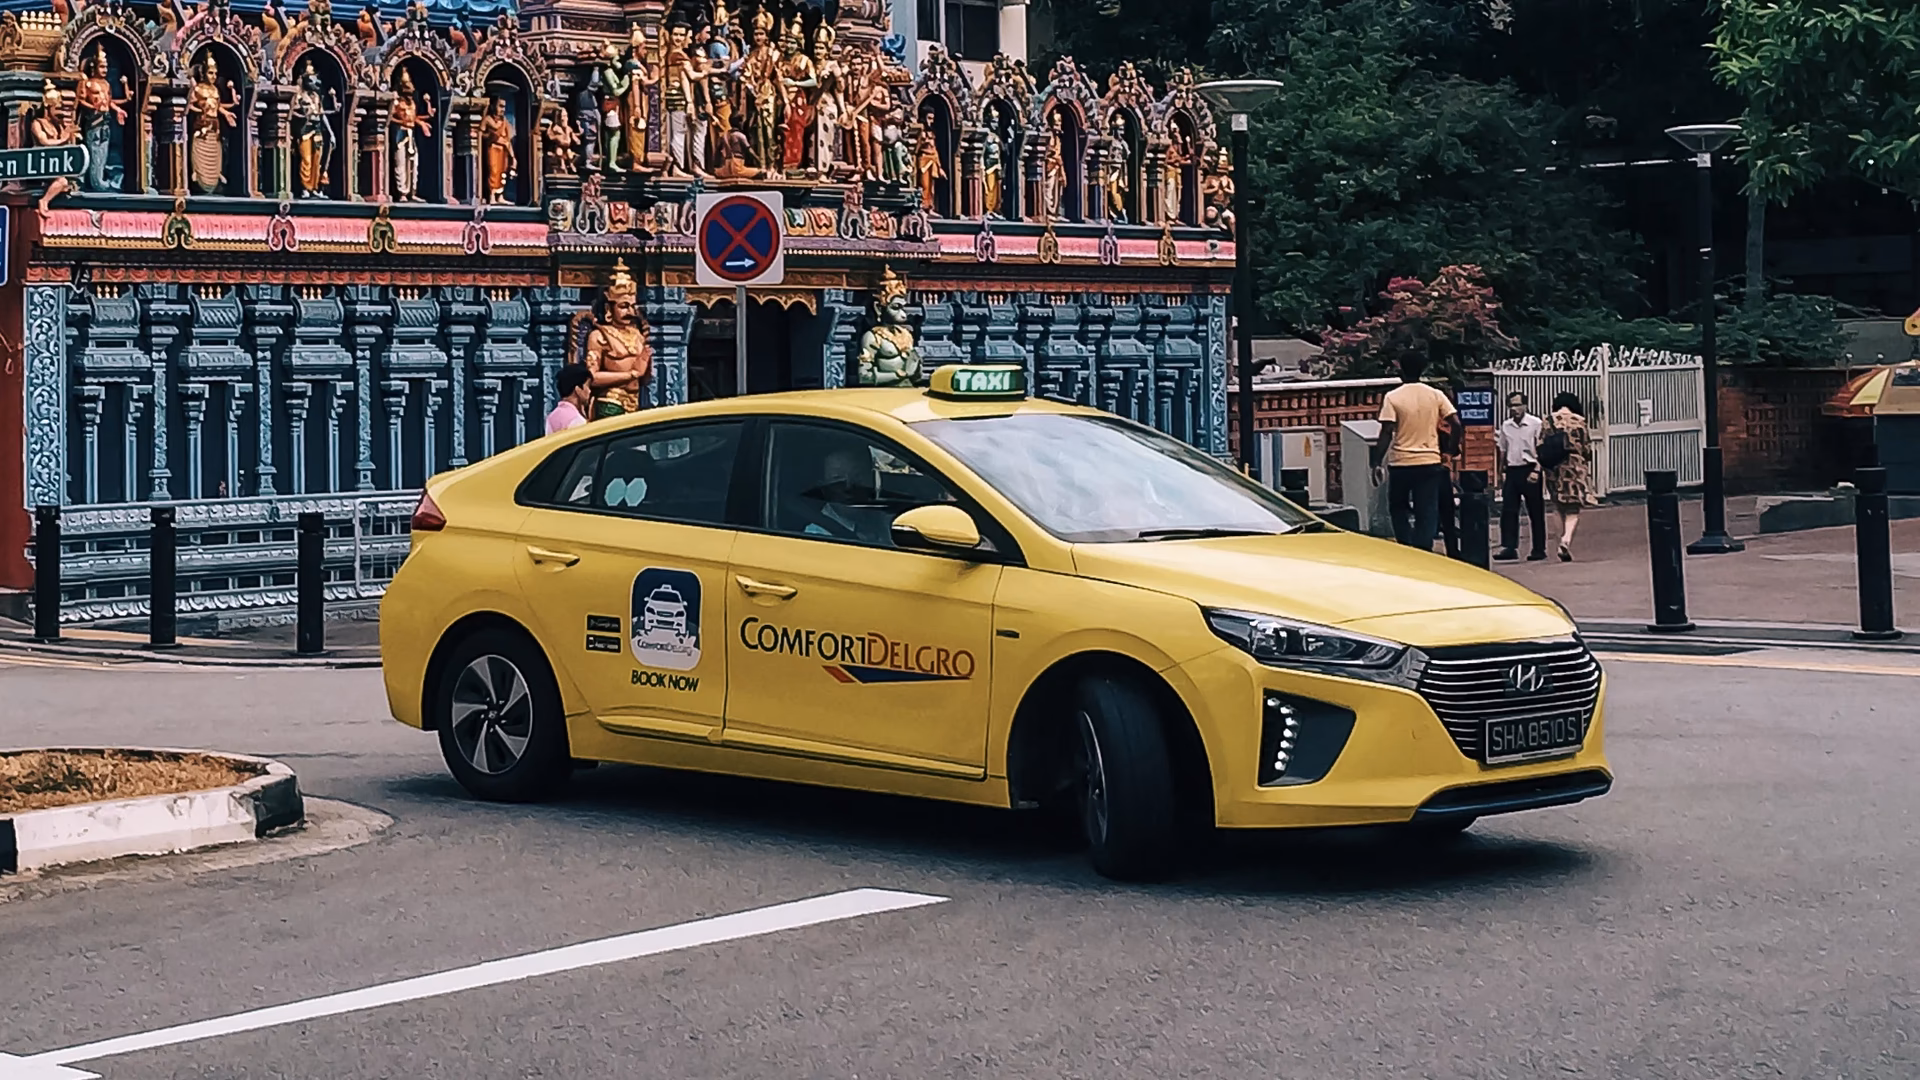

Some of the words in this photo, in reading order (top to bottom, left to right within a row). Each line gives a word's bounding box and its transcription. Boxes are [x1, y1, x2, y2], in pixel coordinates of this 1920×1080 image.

[27, 150, 74, 174] Link
[954, 371, 1011, 391] TAXI
[631, 669, 667, 688] BOOK
[667, 676, 699, 692] NOW
